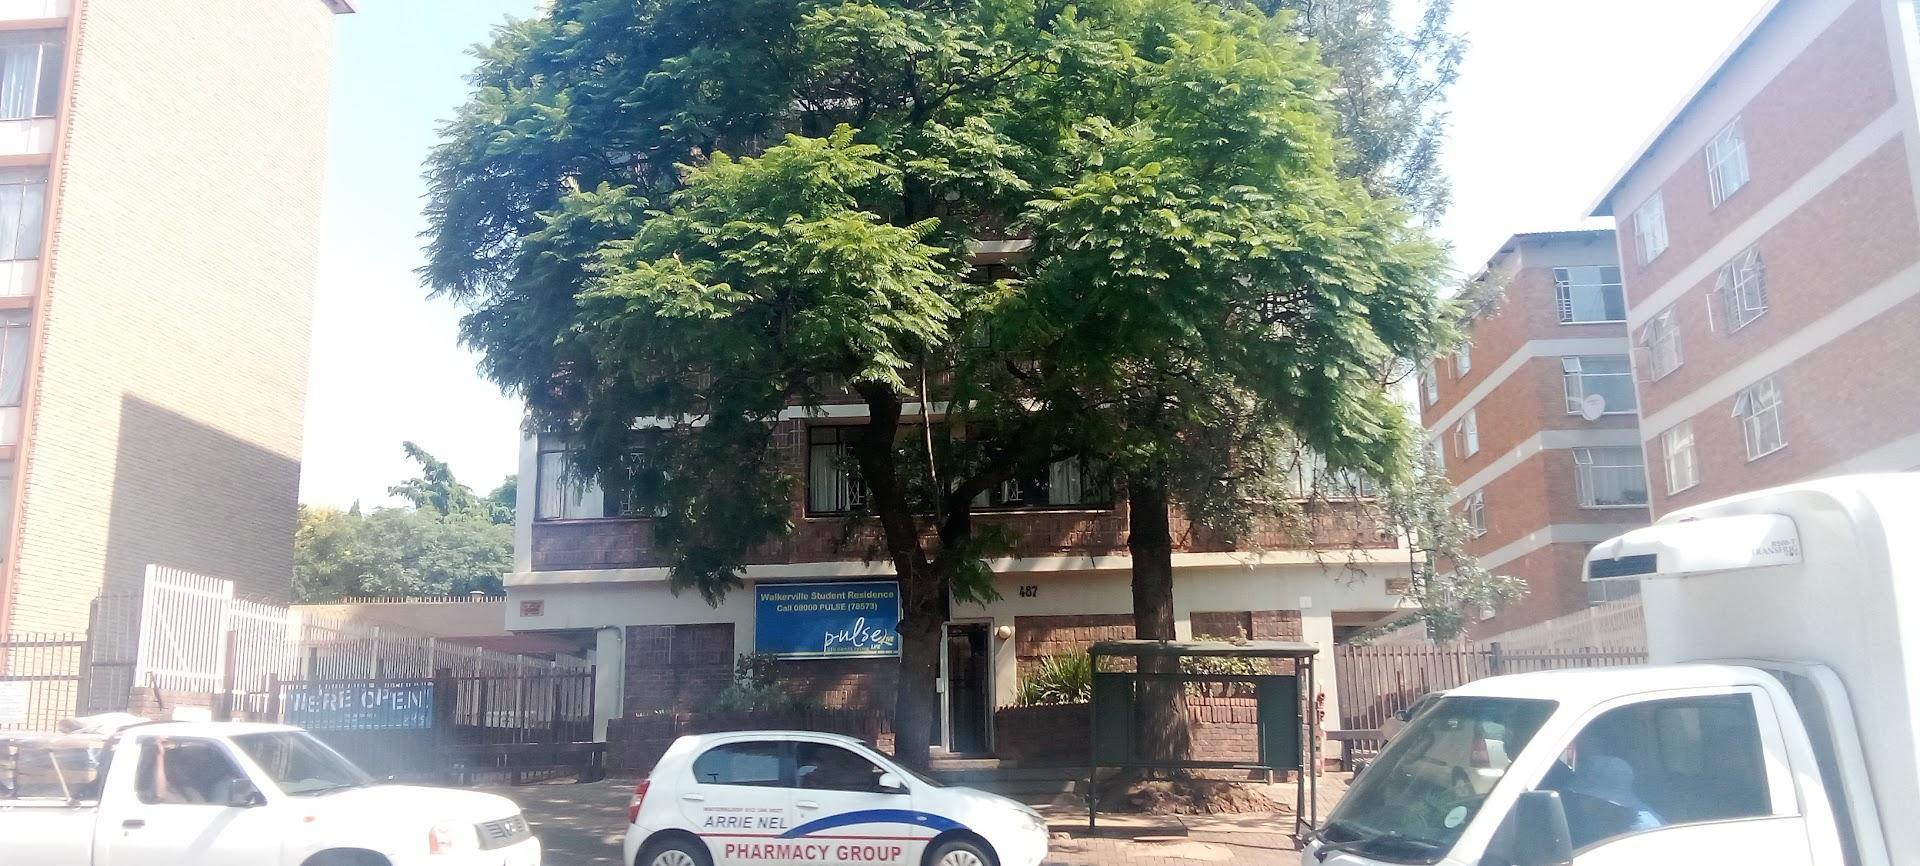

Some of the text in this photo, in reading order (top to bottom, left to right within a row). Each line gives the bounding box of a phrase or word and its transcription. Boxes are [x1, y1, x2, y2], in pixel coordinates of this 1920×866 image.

[760, 590, 894, 601] Walkerville Student Residence
[1019, 585, 1038, 598] 487
[776, 604, 792, 612] Call
[793, 603, 818, 611] 08000
[820, 603, 847, 611] PULSE
[823, 617, 883, 656] pulse
[704, 815, 788, 829] ARRIE NEL
[725, 843, 902, 861] PHARMACY GROUP
